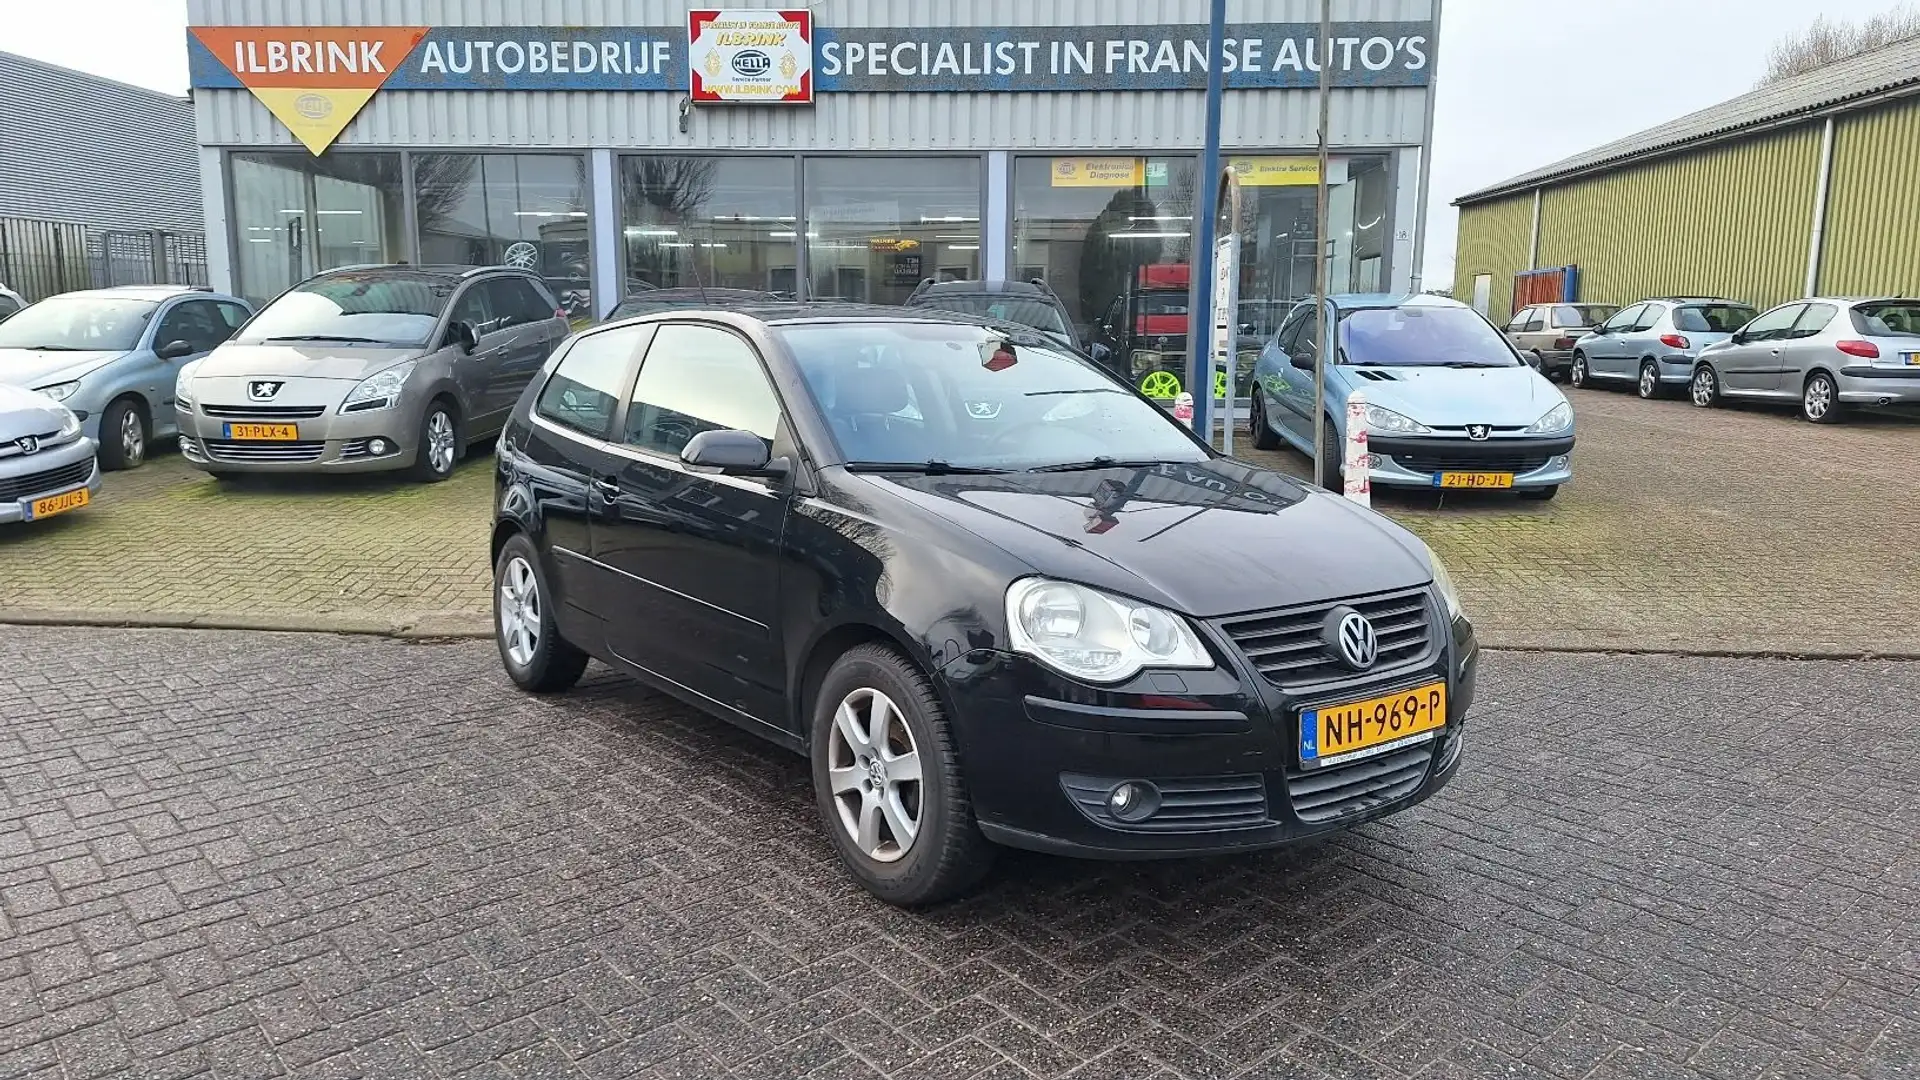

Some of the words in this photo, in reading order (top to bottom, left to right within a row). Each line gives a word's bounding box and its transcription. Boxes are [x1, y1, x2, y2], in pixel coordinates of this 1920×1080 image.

[716, 32, 787, 46] ILBRINK
[235, 41, 387, 73] ILBRINK
[420, 41, 671, 74] AUTOBEDRIJF
[821, 41, 1040, 76] SPECIALIST
[1051, 41, 1094, 74] IN
[1105, 38, 1262, 74] FRANSE
[1272, 36, 1426, 72] AUTO'S
[704, 85, 799, 95] WWW.ILBRINK.COM
[1289, 164, 1318, 172] Service
[1089, 171, 1130, 180] Diagnose
[236, 426, 289, 438] 31-PLX-4
[1448, 474, 1505, 486] 21-HD-JL
[39, 491, 84, 514] 86-JJL-3
[1325, 690, 1440, 748] NH-969-P
[1303, 740, 1316, 750] NL
